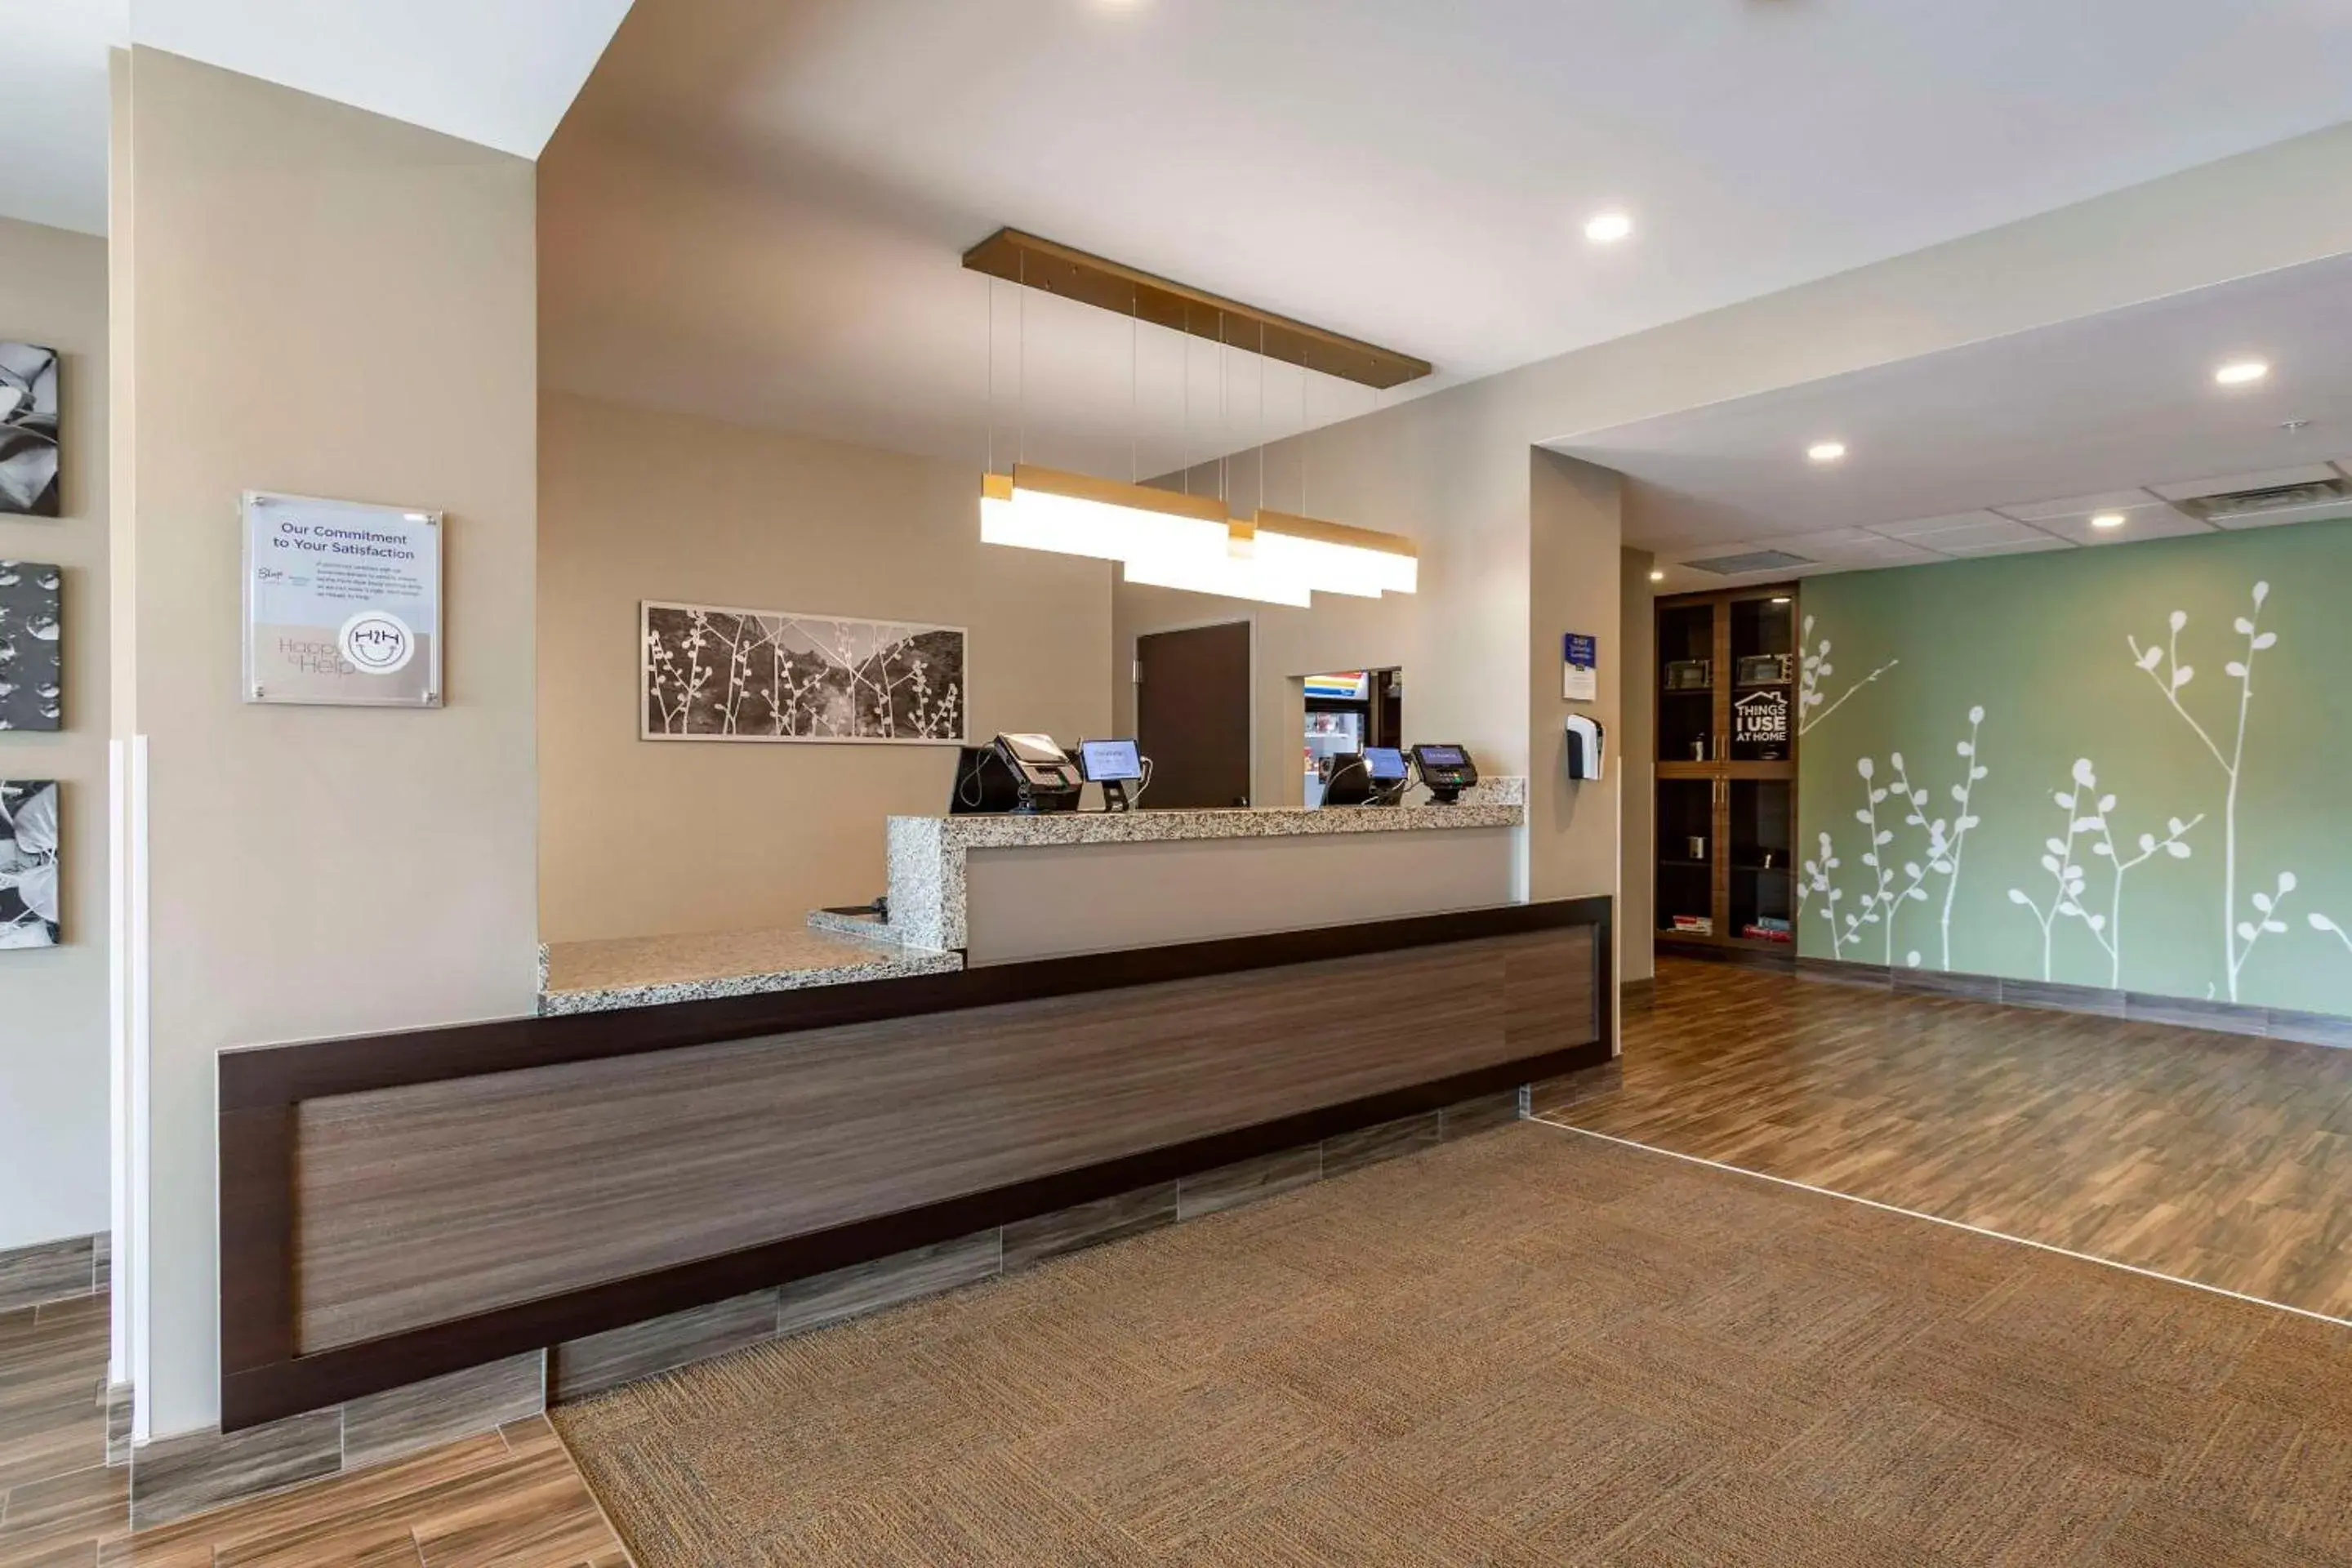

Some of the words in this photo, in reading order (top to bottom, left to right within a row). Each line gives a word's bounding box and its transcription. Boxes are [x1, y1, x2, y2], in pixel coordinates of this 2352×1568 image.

[281, 523, 310, 535] Our
[314, 526, 408, 545] Commitment
[273, 537, 289, 548] to
[294, 539, 327, 552] Your
[332, 542, 415, 559] Satisfaction
[355, 630, 399, 644] H2H
[1737, 704, 1786, 715] THINGS
[1736, 717, 1742, 732] I
[1748, 716, 1786, 732] USE
[1735, 732, 1751, 742] AT
[1753, 732, 1786, 742] HOME
